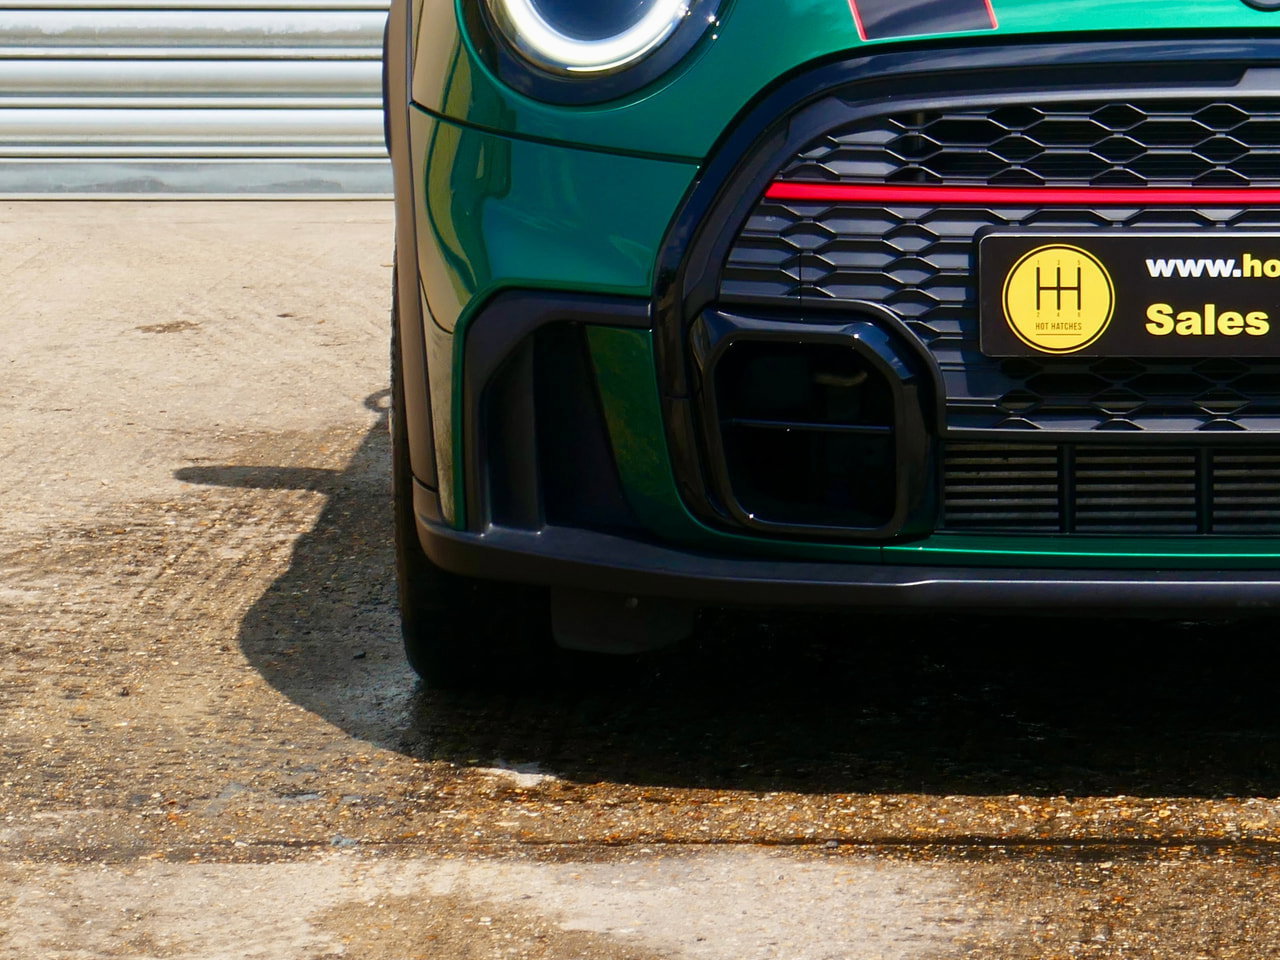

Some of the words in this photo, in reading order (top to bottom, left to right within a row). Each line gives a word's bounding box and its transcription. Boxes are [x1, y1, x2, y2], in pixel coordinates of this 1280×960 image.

[1035, 322, 1049, 331] HOT
[1050, 321, 1082, 331] HATCHES
[1145, 302, 1270, 336] Sales
